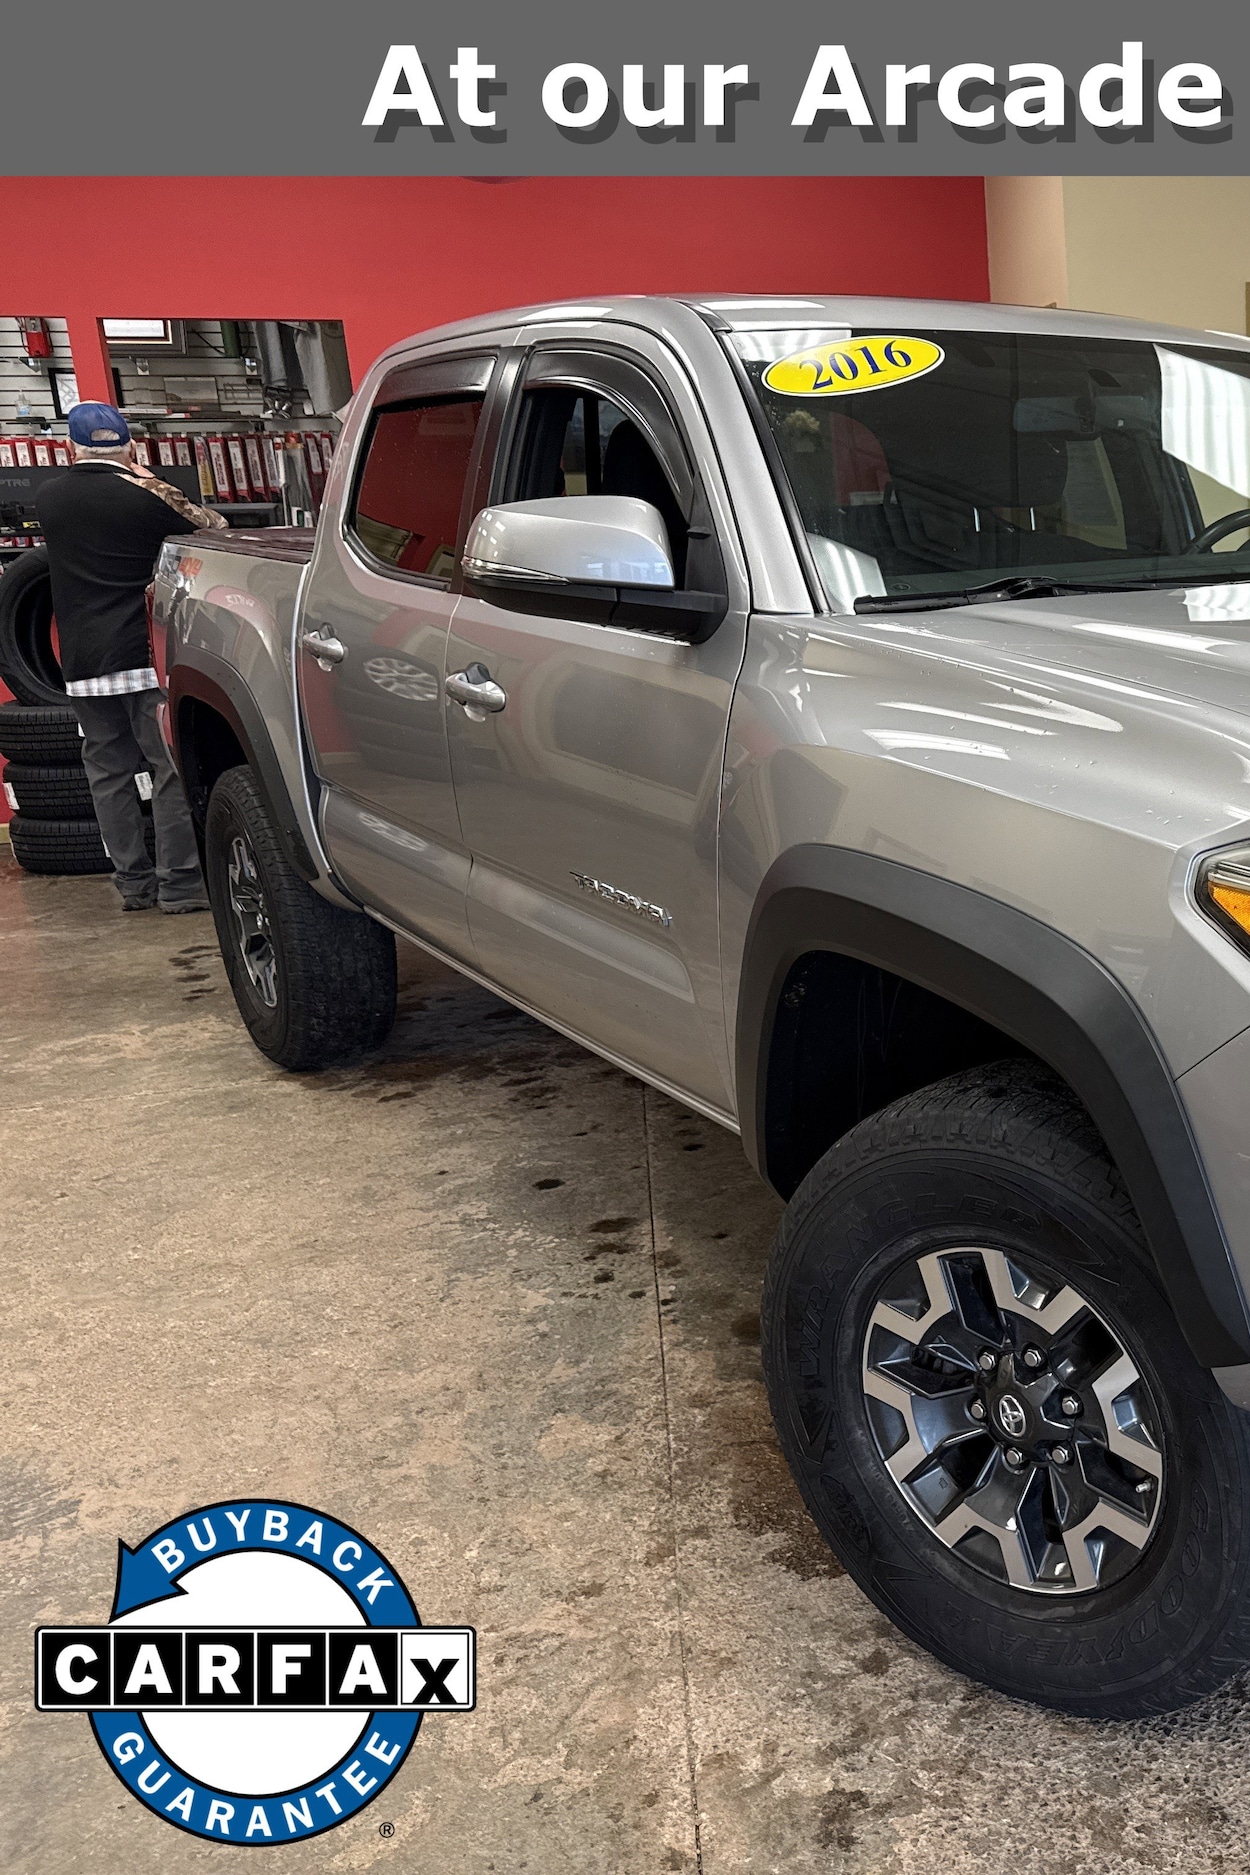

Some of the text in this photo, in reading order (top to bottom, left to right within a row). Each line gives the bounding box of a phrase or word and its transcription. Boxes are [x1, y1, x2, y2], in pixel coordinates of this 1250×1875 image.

[799, 340, 912, 390] 2016
[799, 1193, 1041, 1378] WRANGLER
[937, 1478, 1210, 1666] GOODYEAR
